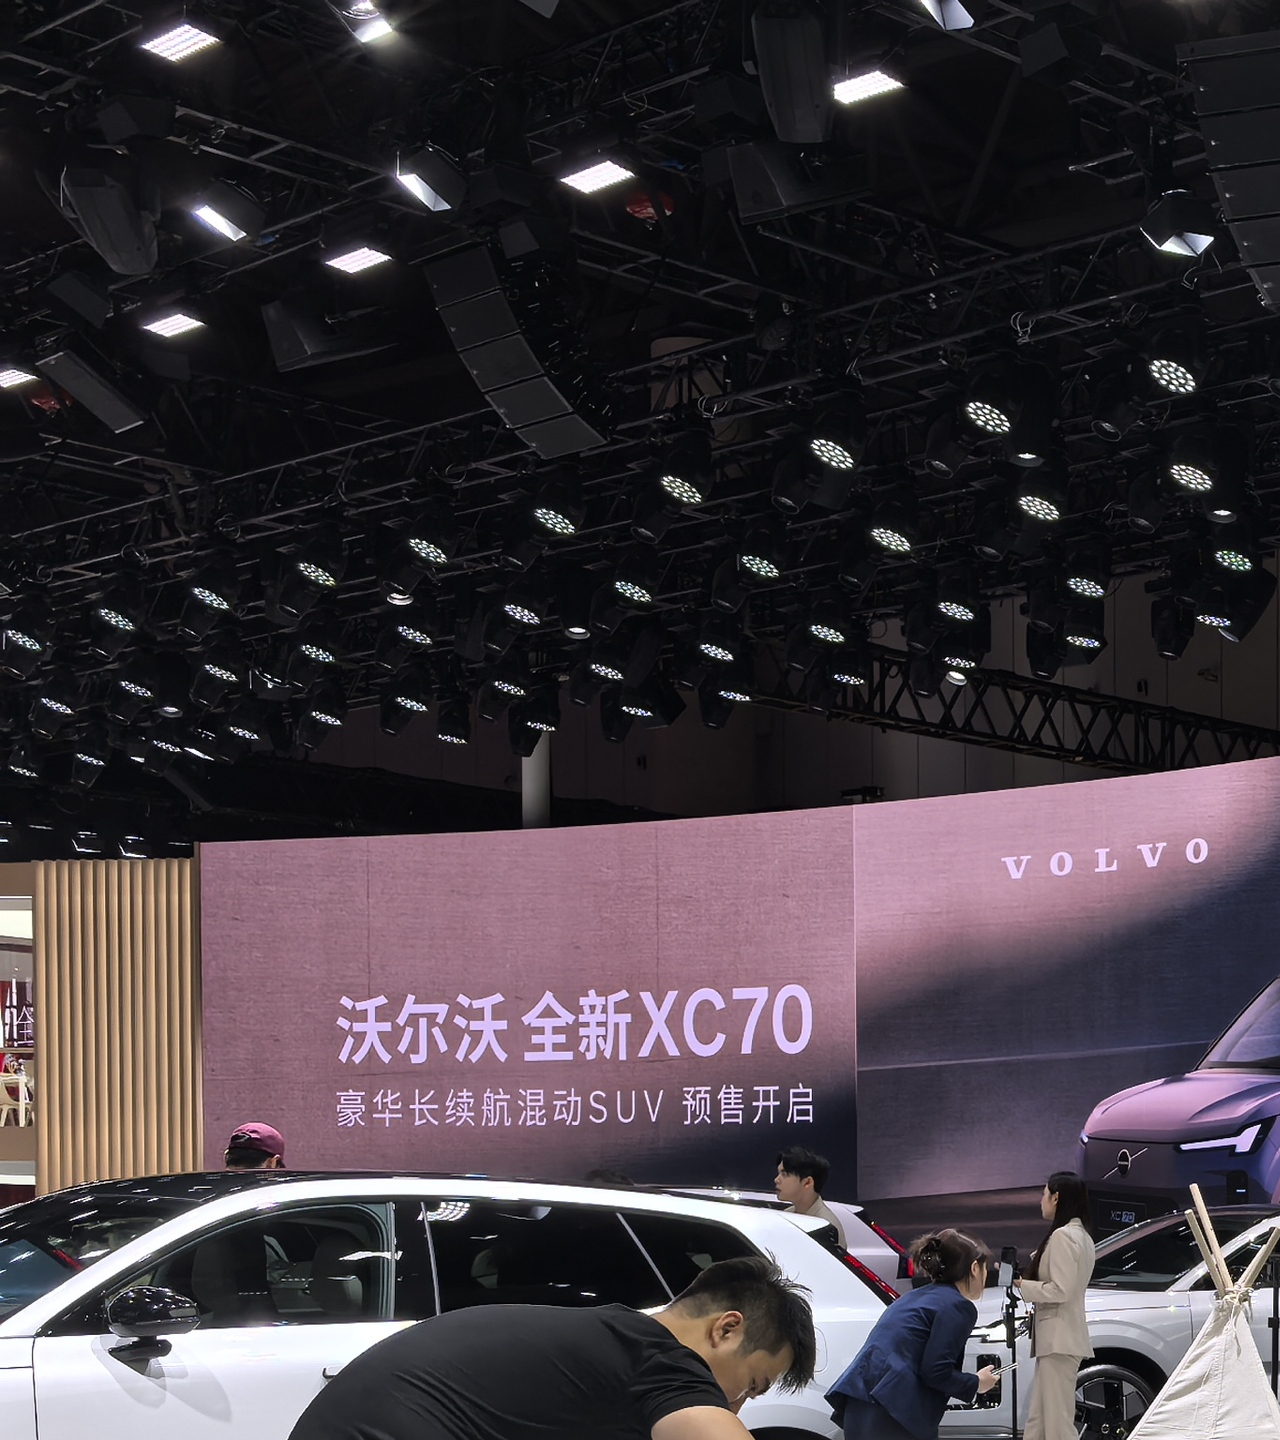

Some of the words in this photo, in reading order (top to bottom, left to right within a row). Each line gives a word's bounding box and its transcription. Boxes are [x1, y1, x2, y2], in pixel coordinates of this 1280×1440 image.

[1001, 837, 1209, 879] VOLVO
[336, 993, 509, 1064] 沃尔沃
[336, 1087, 664, 1127] 豪华长续航混动SUV
[682, 1083, 813, 1125] 预售开启
